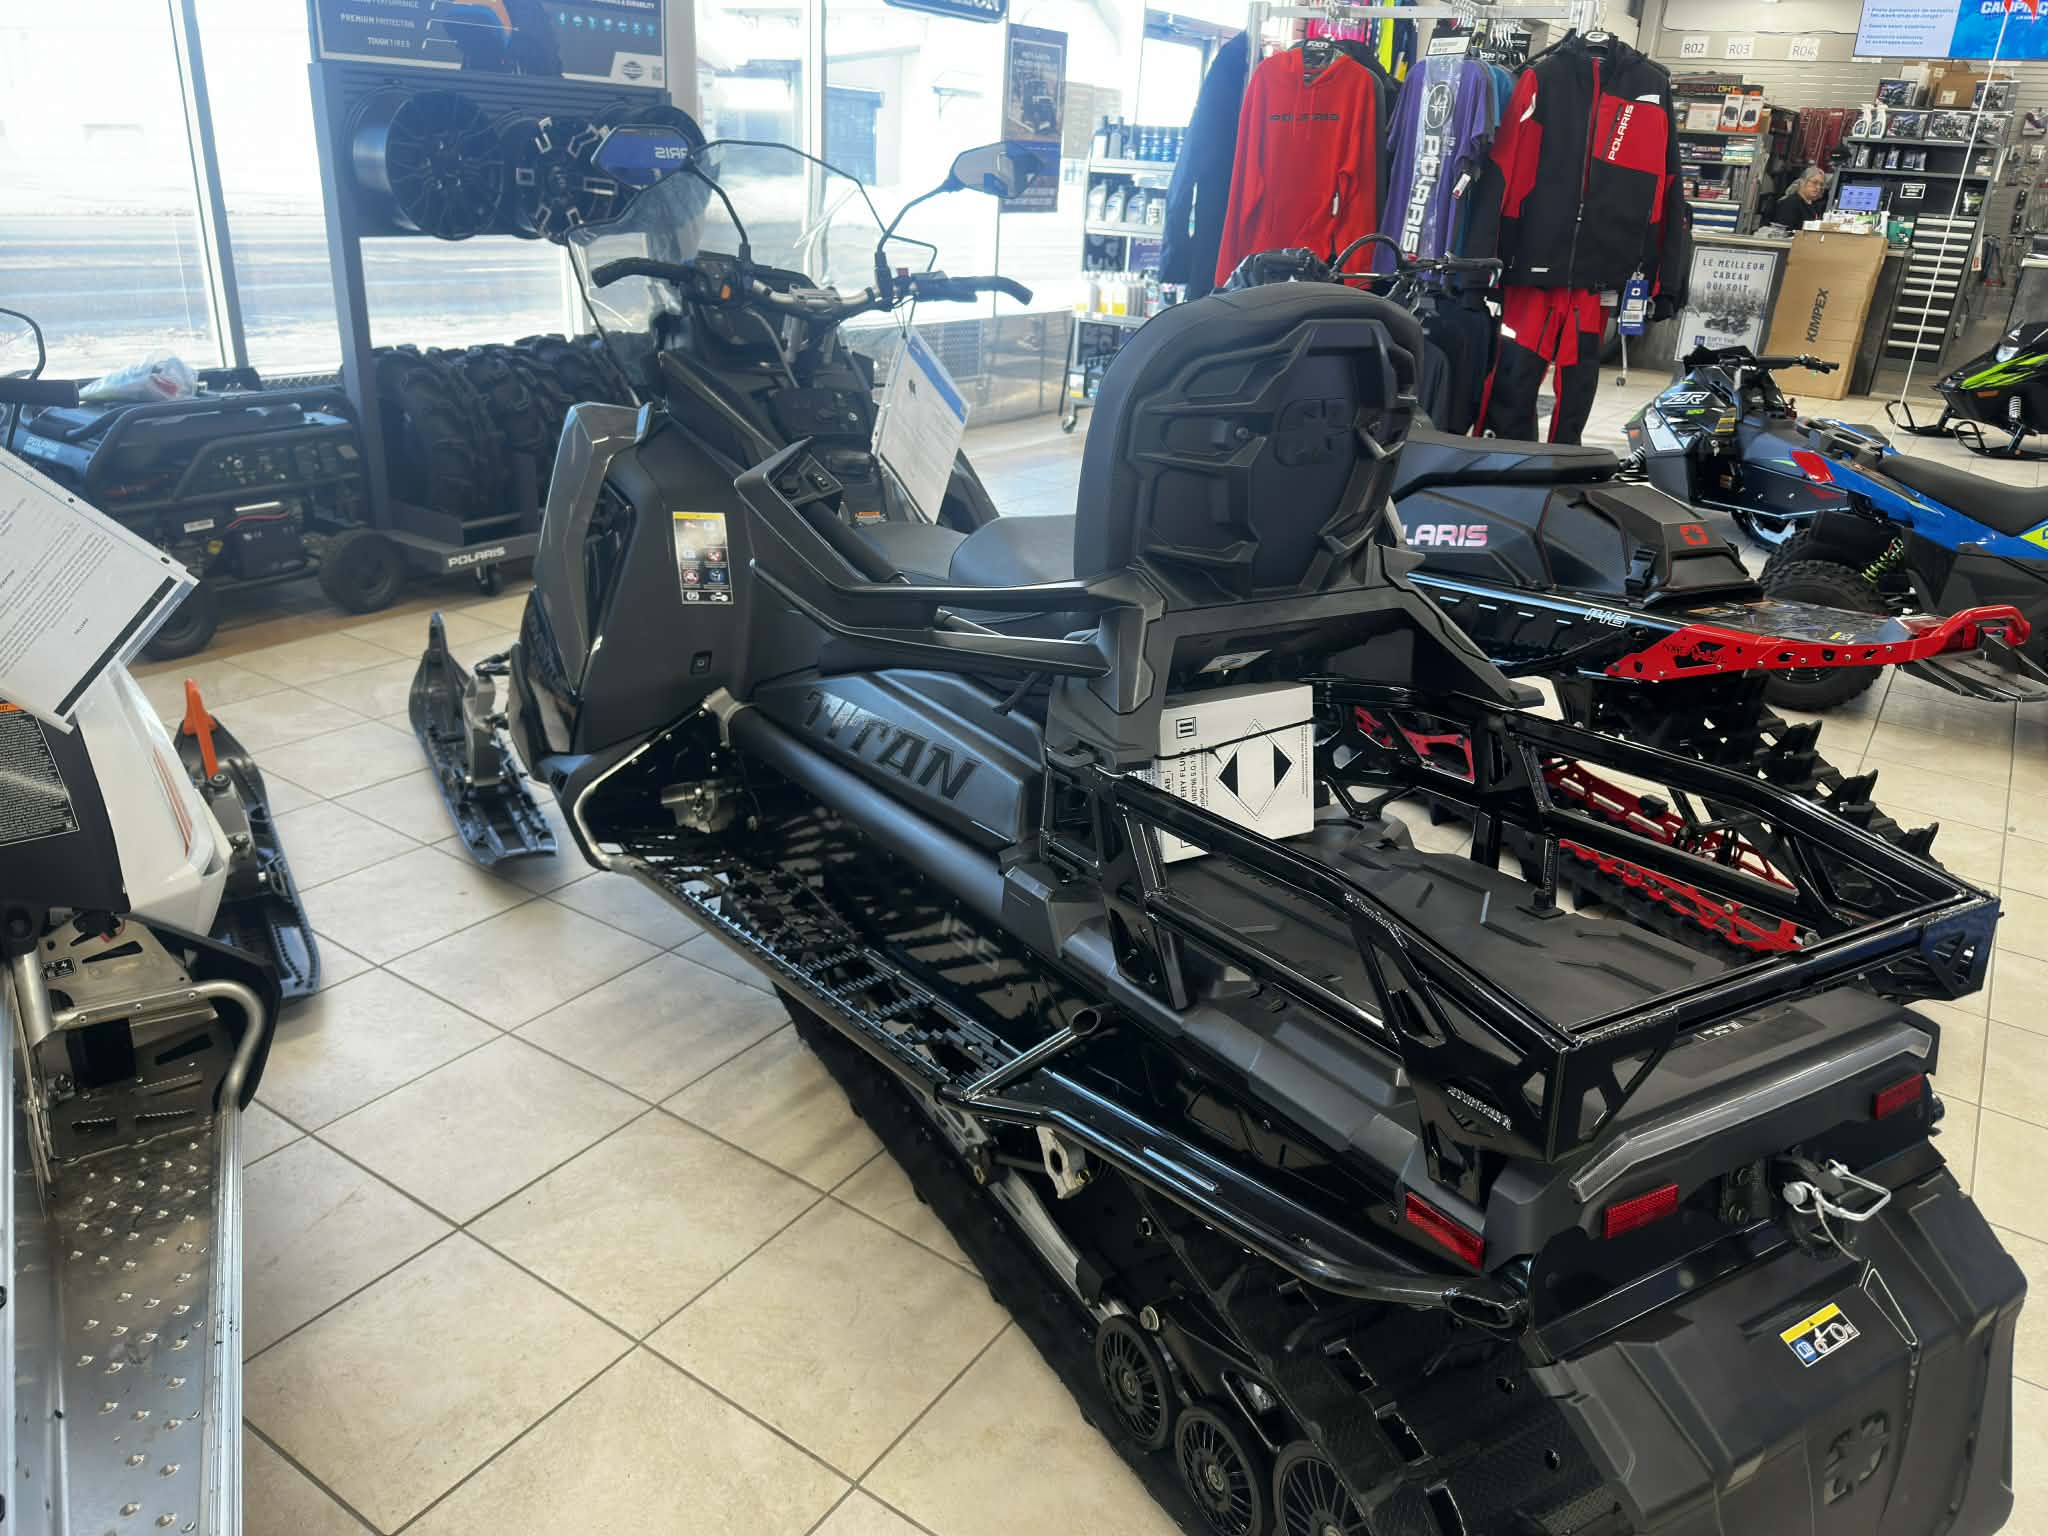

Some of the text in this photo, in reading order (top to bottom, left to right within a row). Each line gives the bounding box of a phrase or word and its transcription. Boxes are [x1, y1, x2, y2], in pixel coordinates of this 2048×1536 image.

[1683, 43, 1705, 54] R02
[1728, 44, 1750, 56] R03
[1607, 104, 1634, 161] POLARIS
[1403, 135, 1440, 253] POLARIS
[1712, 270, 1750, 281] CADEAU
[1717, 259, 1765, 271] MEILLEUR
[1805, 287, 1829, 344] KIMPEX
[1403, 524, 1489, 547] LARIS
[448, 546, 505, 569] POLARIS
[803, 687, 982, 801] TITAN
